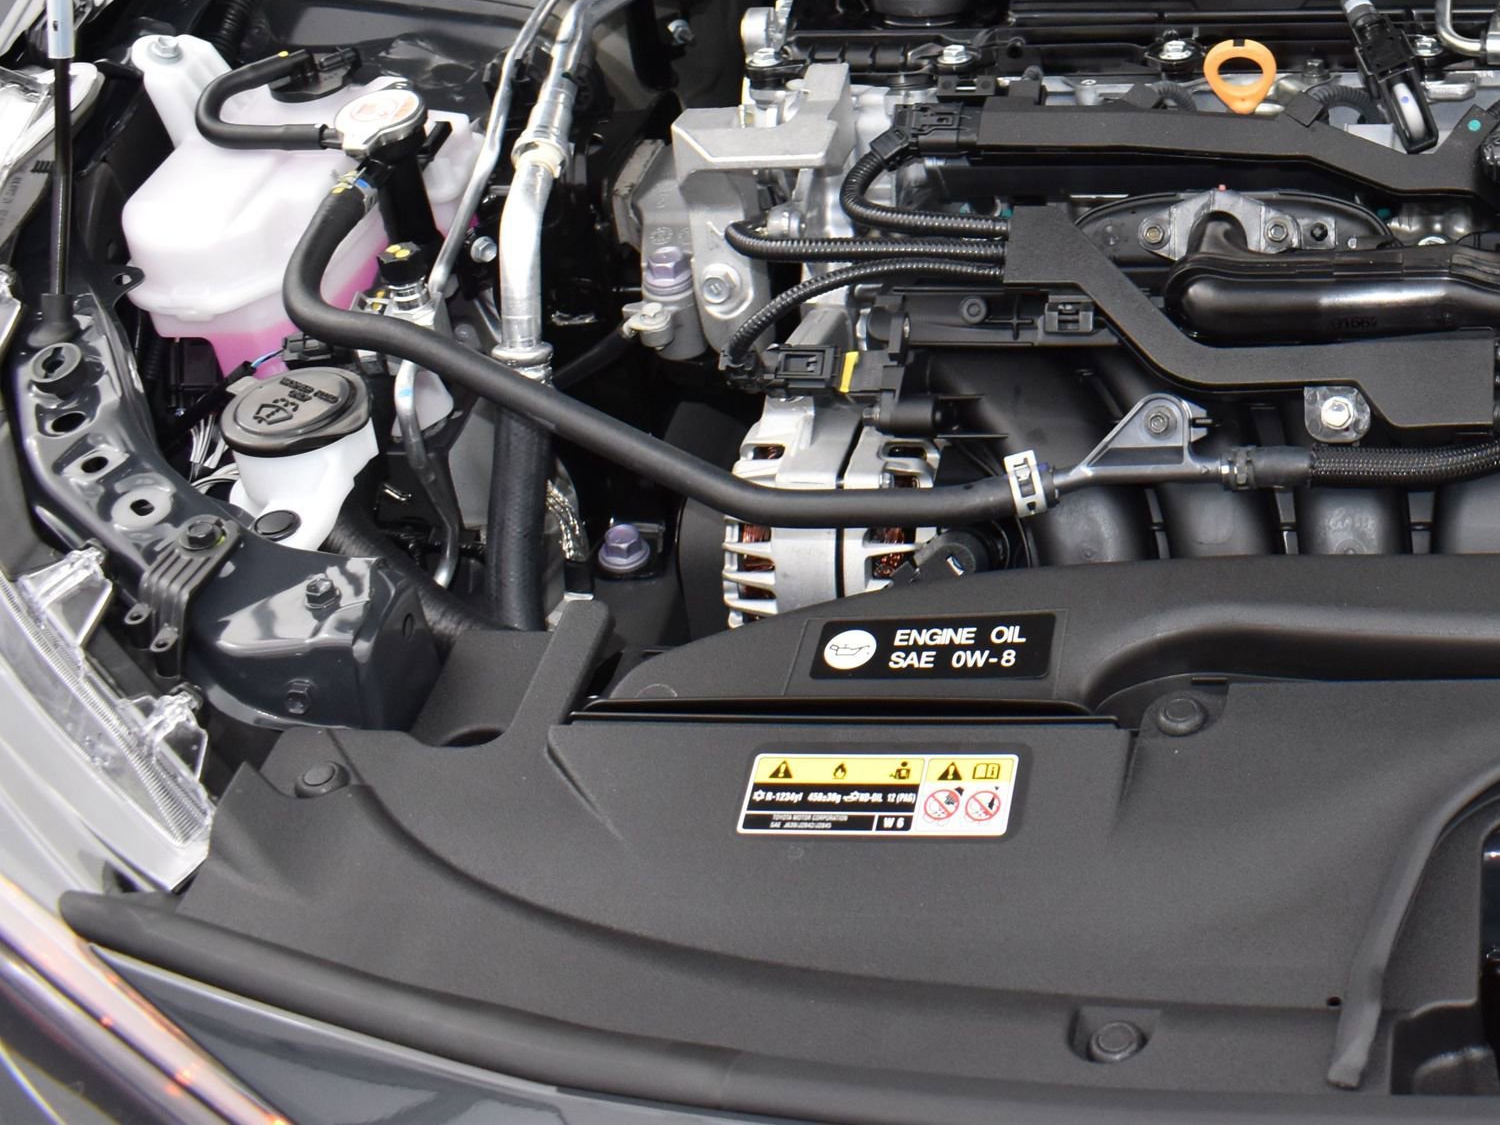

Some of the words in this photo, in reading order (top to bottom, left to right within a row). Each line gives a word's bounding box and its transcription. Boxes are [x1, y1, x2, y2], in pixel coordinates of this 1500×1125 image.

[893, 627, 978, 646] ENGINE
[990, 625, 1026, 644] OIL
[888, 650, 937, 669] SAE
[951, 649, 1016, 668] 0W-8
[887, 792, 896, 803] 12
[883, 817, 895, 828] W
[896, 817, 905, 828] 6
